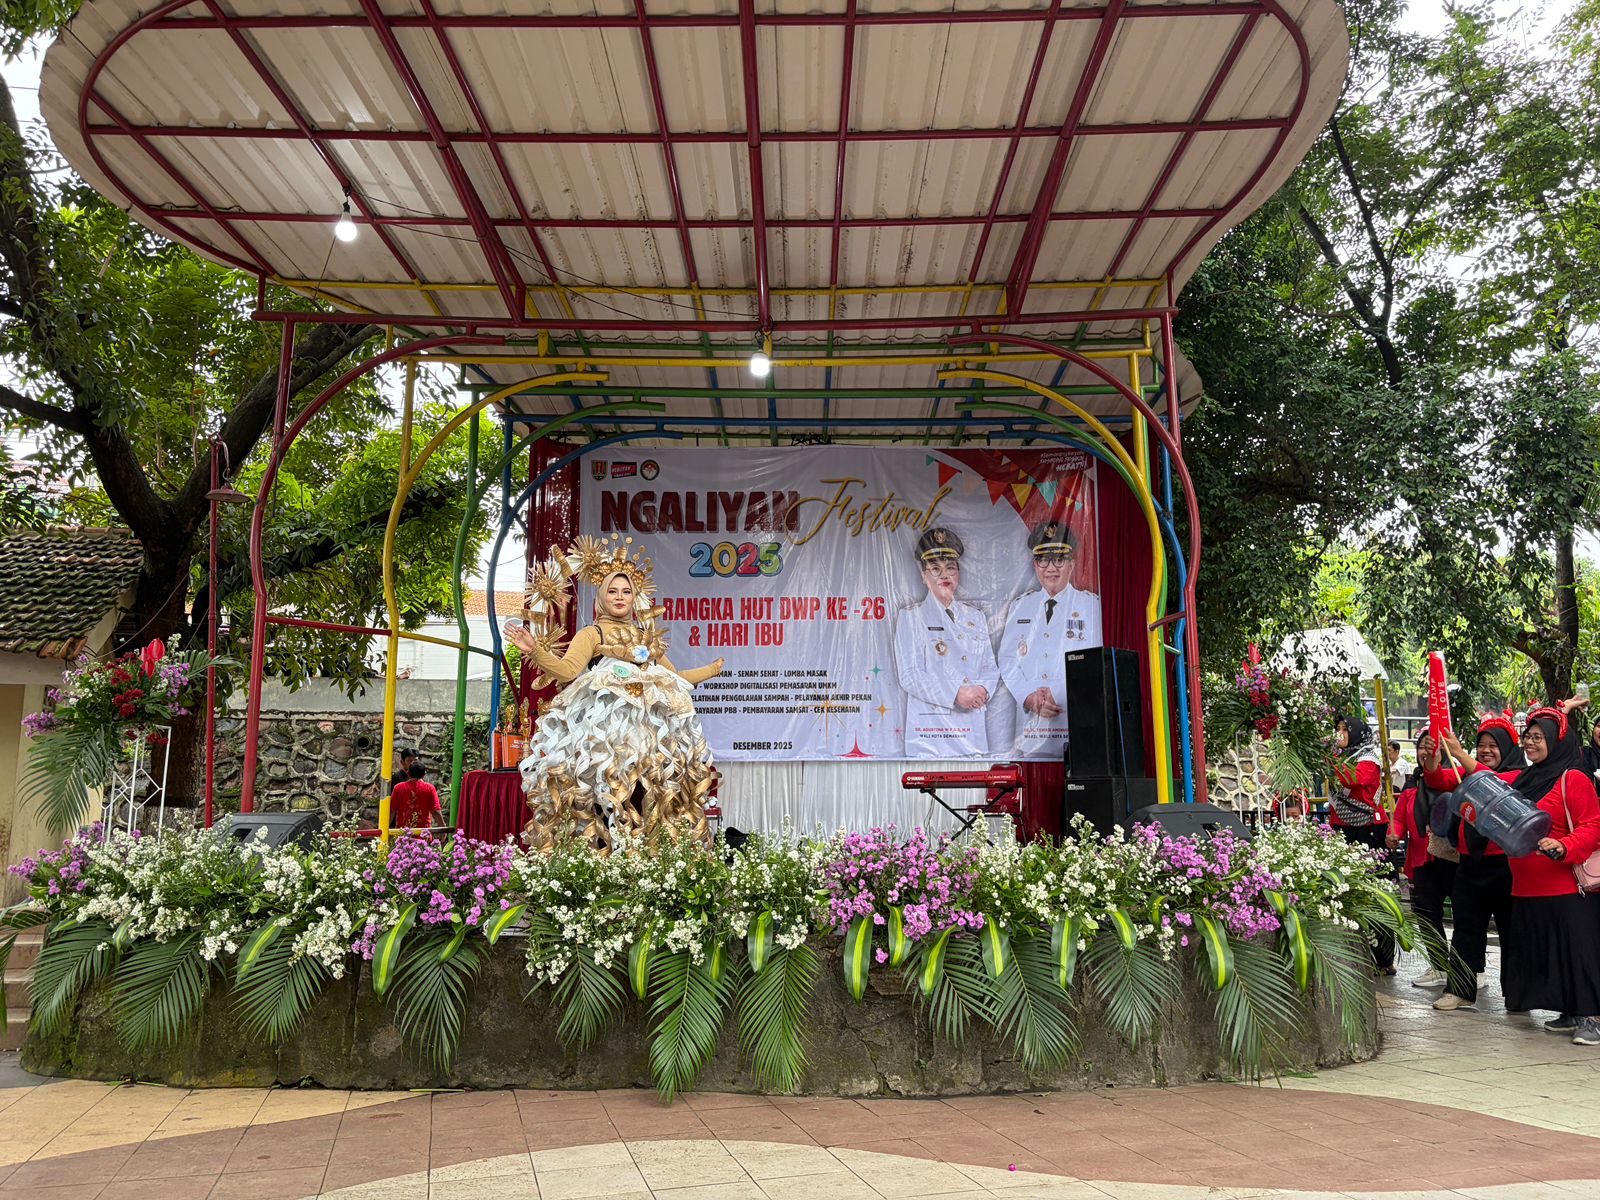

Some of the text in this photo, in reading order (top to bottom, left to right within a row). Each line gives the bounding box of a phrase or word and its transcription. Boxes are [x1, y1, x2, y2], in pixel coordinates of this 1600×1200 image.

[600, 476, 953, 546] NGALIYAN Festival
[688, 541, 784, 578] 2025
[662, 597, 734, 621] RANGKA
[740, 597, 773, 621] HUT
[780, 597, 821, 620] DWP
[827, 597, 848, 620] KE
[688, 622, 785, 647] & HARI IBU
[737, 670, 759, 678] SENAM
[760, 670, 779, 678] SEHAT
[784, 670, 806, 678] LOMBA
[806, 670, 828, 678] MASAK
[703, 682, 739, 690] WORKSHOP
[739, 682, 779, 690] DIGITALISASI
[691, 694, 720, 702] ELATIHAN
[721, 694, 763, 702] PENGOLAHAN
[763, 694, 790, 702] SAMPAH
[794, 694, 830, 702] PELAYANAN
[1437, 681, 1447, 710] LOVE
[724, 706, 738, 714] PBB
[742, 706, 784, 714] PEMBAYARAN
[733, 741, 793, 750] DESEMBER 2025
